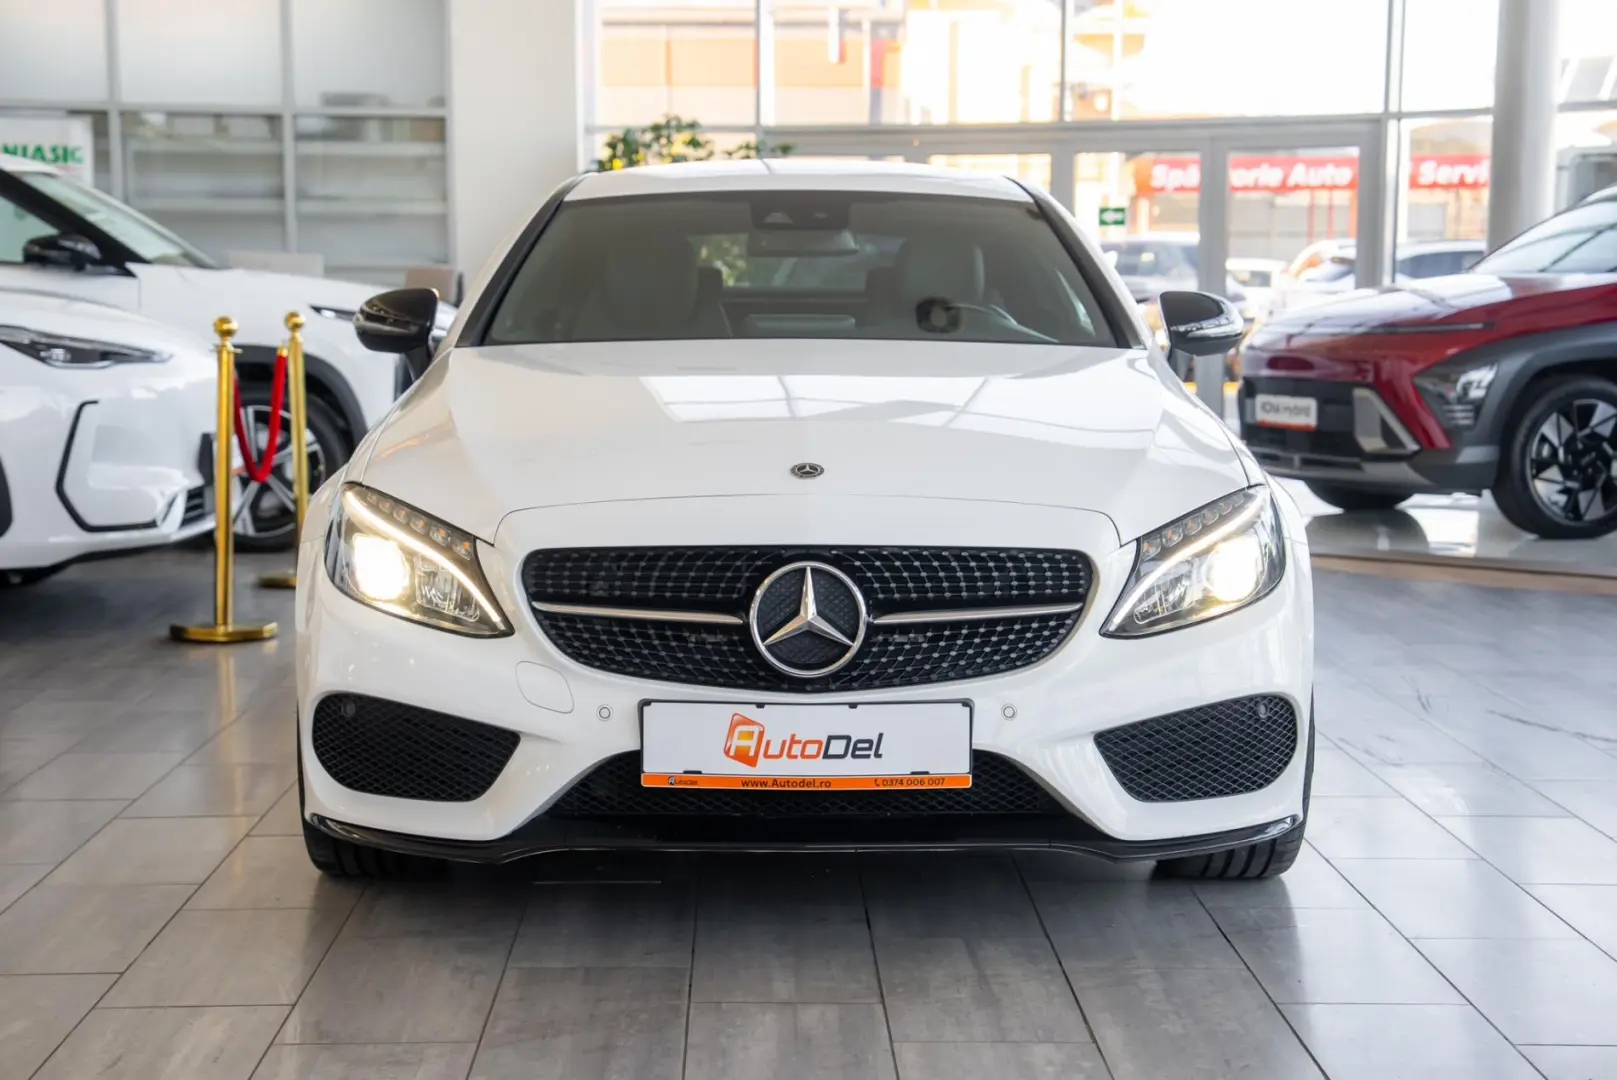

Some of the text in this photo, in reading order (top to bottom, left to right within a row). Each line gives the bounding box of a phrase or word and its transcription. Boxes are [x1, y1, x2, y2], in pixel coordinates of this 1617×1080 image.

[1286, 163, 1353, 187] Auto
[728, 722, 884, 761] AutoDel
[741, 777, 945, 789] www.Autodel.ro 0374 006 007
